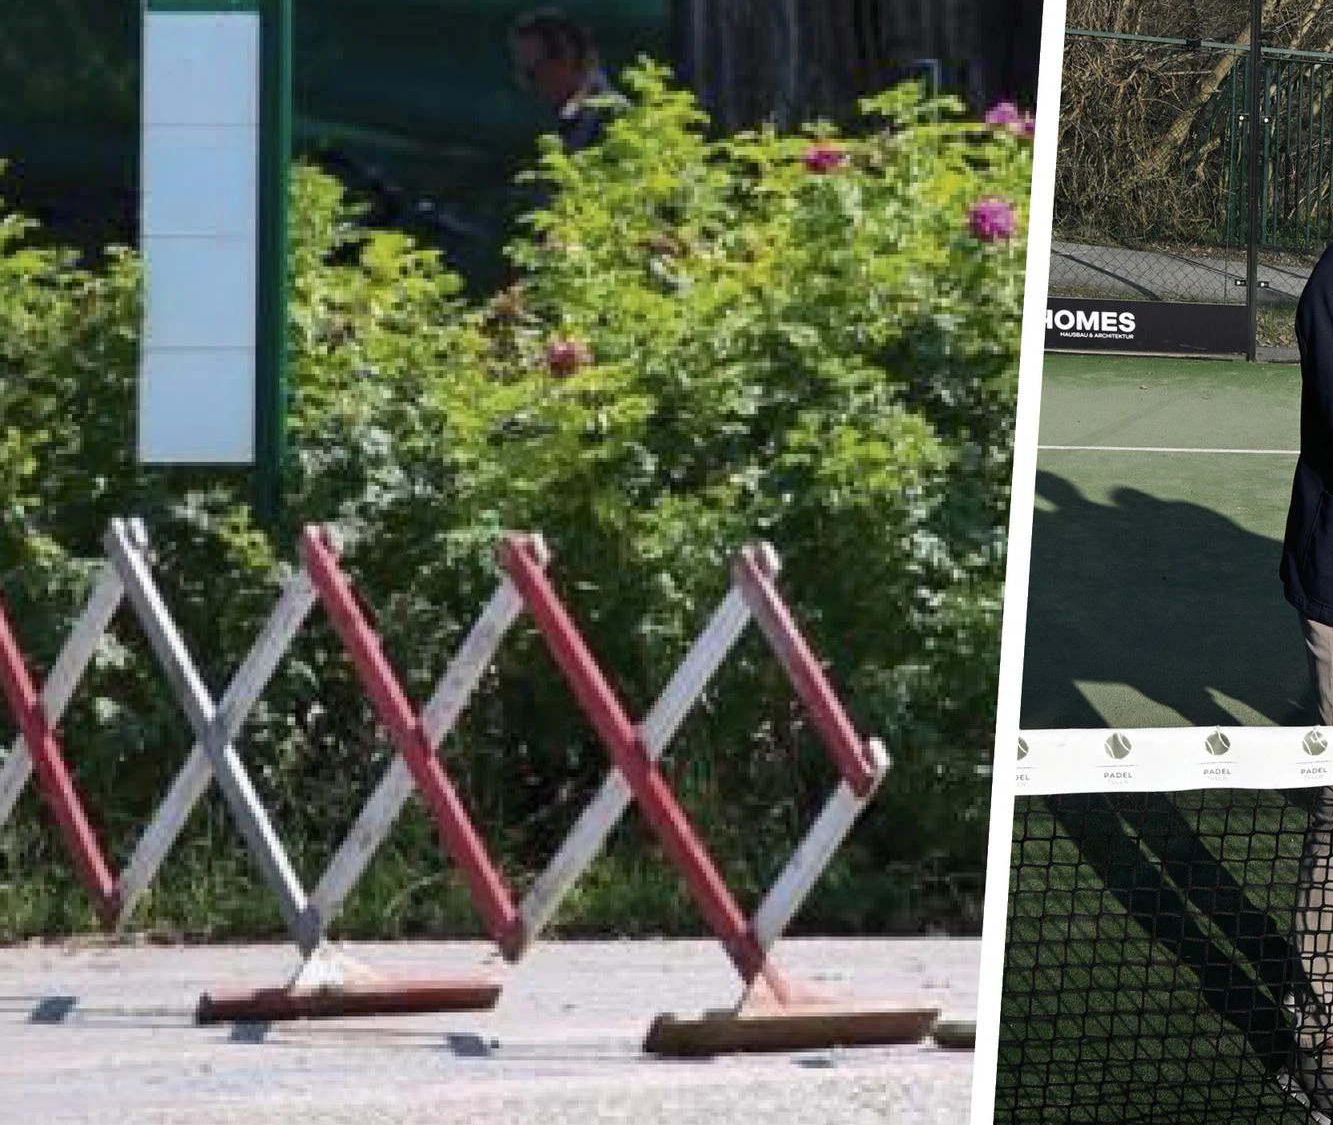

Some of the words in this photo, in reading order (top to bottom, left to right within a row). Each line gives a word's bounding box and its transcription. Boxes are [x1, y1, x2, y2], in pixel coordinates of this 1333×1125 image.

[1094, 332, 1135, 340] ARCHITEKTUR
[1203, 767, 1232, 776] PADEL
[1300, 766, 1328, 775] PADEL
[1103, 771, 1133, 779] PADEL
